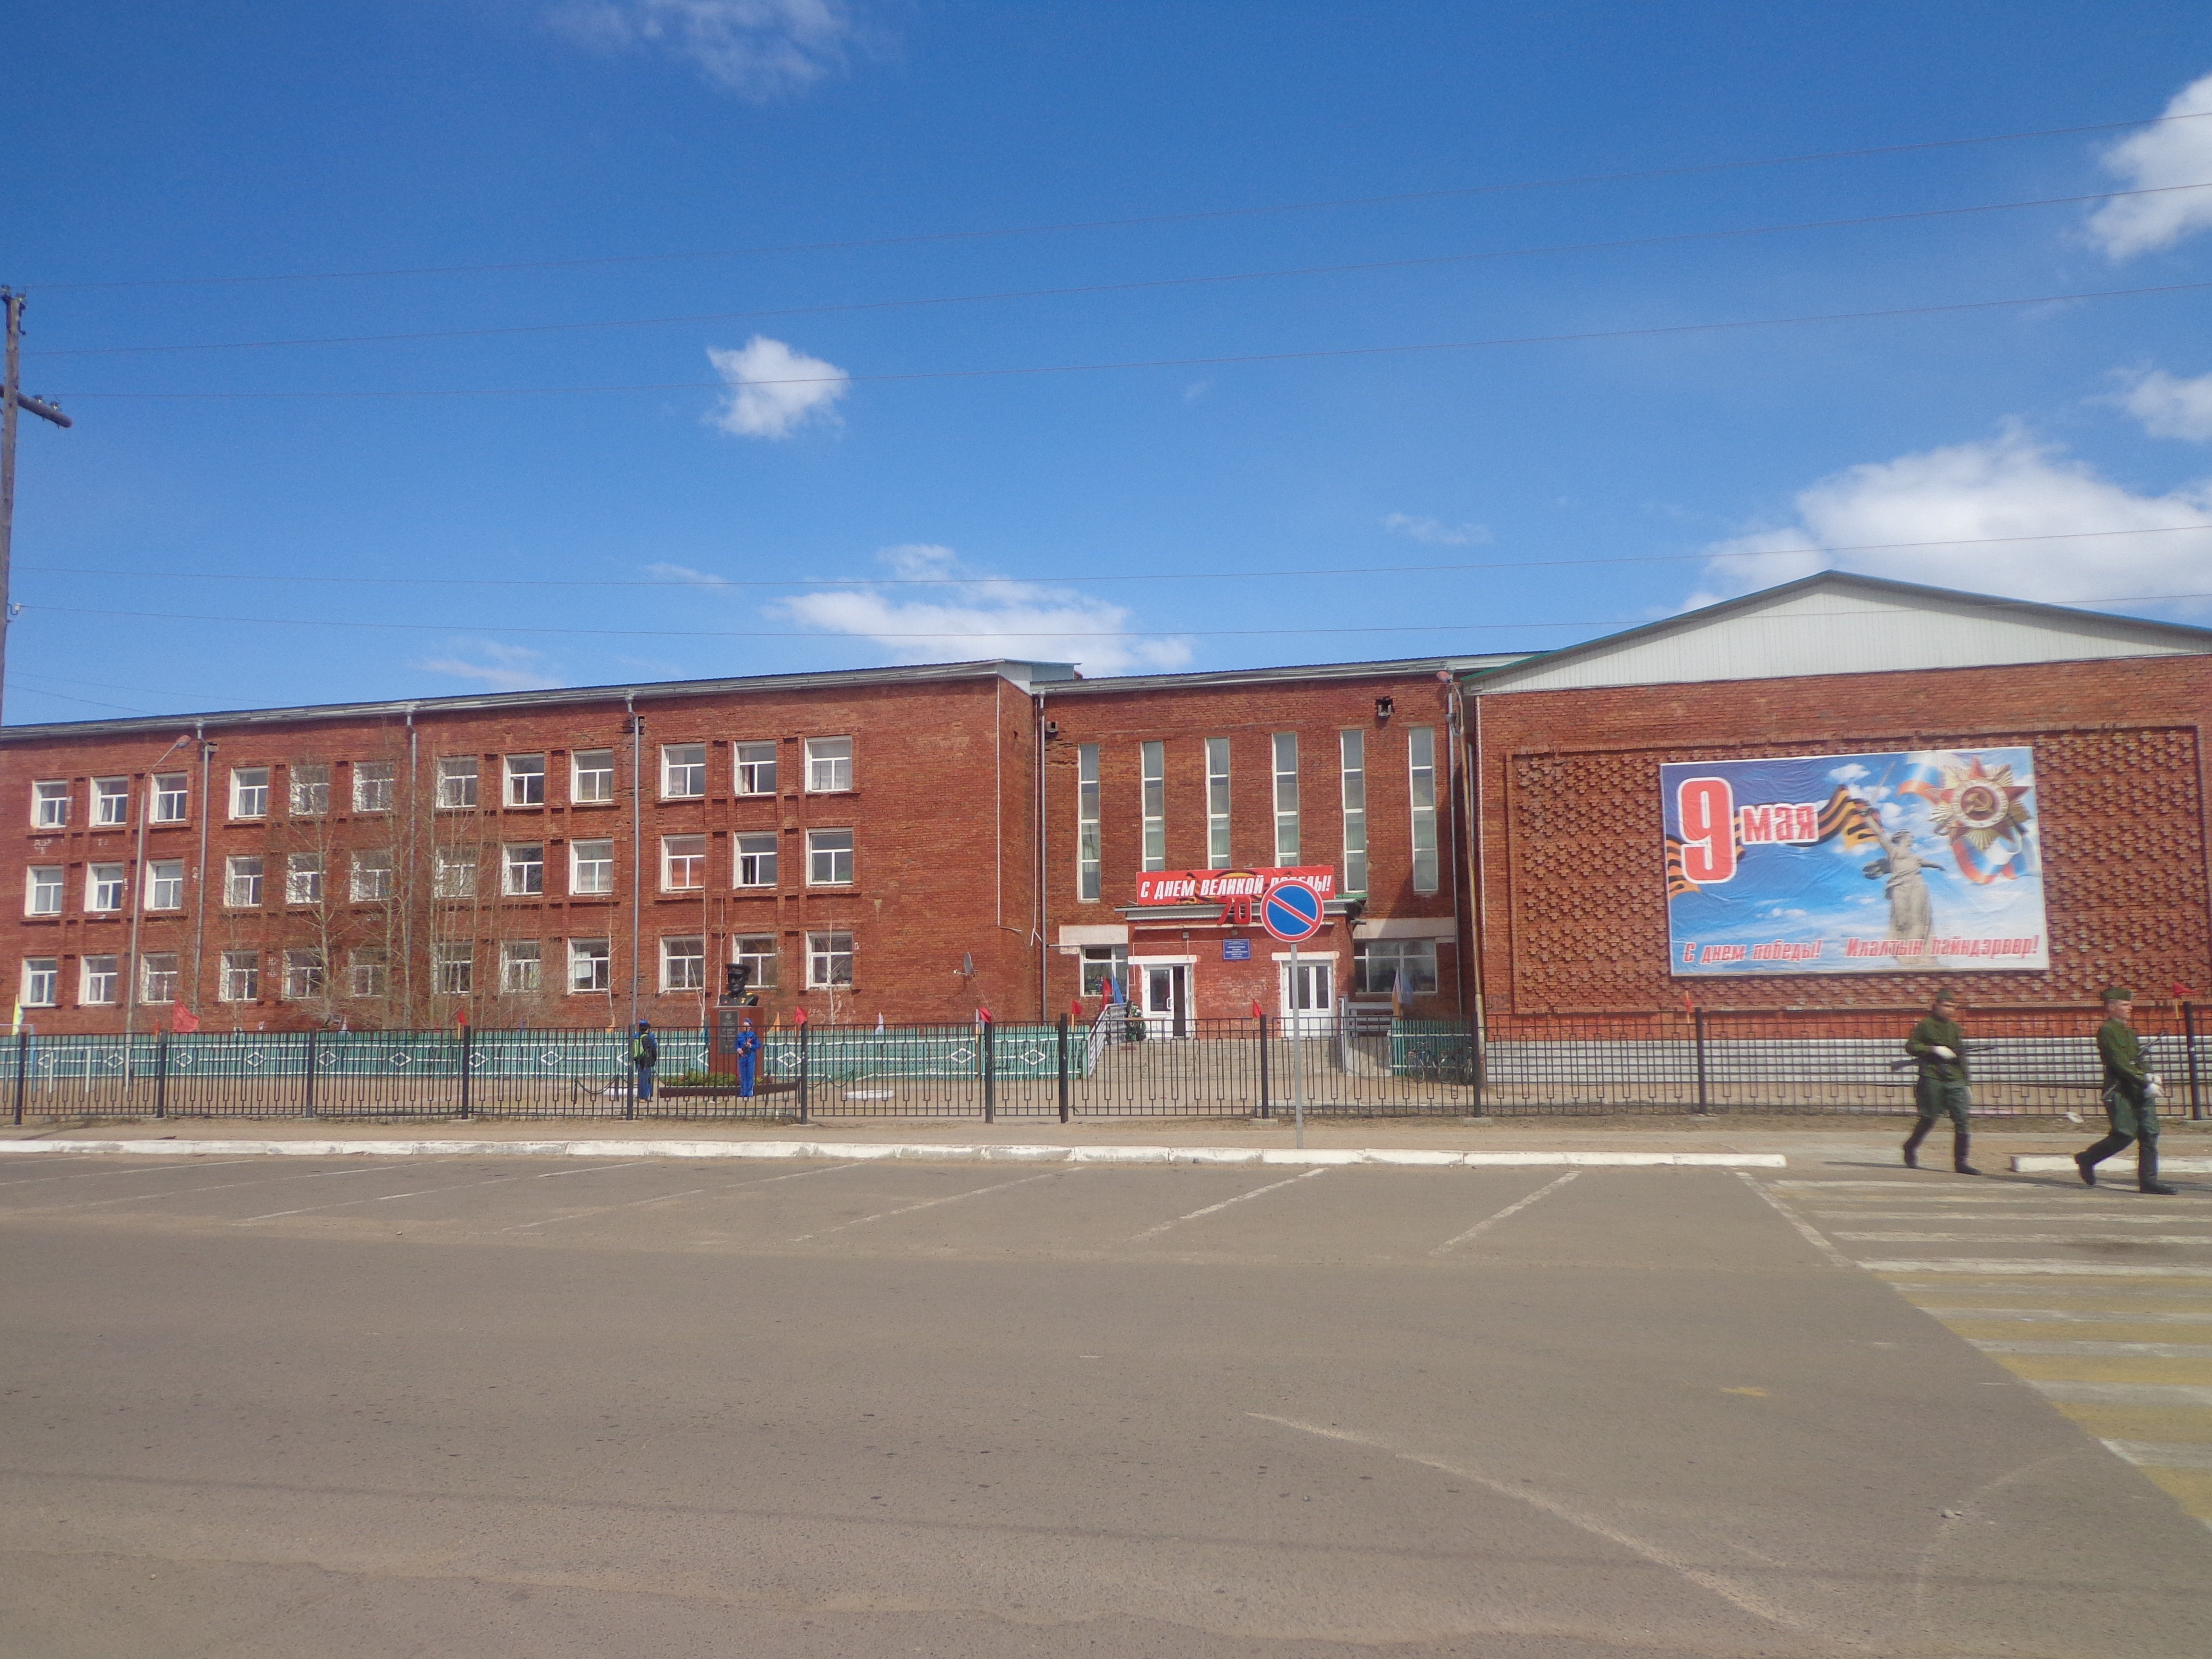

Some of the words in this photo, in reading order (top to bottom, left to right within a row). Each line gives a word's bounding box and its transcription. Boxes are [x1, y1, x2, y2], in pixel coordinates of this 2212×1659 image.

[1678, 777, 1737, 884] 9
[1140, 881, 1150, 898] С
[1154, 879, 1196, 900] ДНЕМ
[1200, 875, 1264, 896] ВЕЛИКОЙ
[1217, 897, 1252, 926] 70
[1683, 942, 1696, 963] С
[1700, 944, 1747, 964] днем
[1752, 938, 1823, 962] победы!
[1845, 937, 1925, 958] Илалтын
